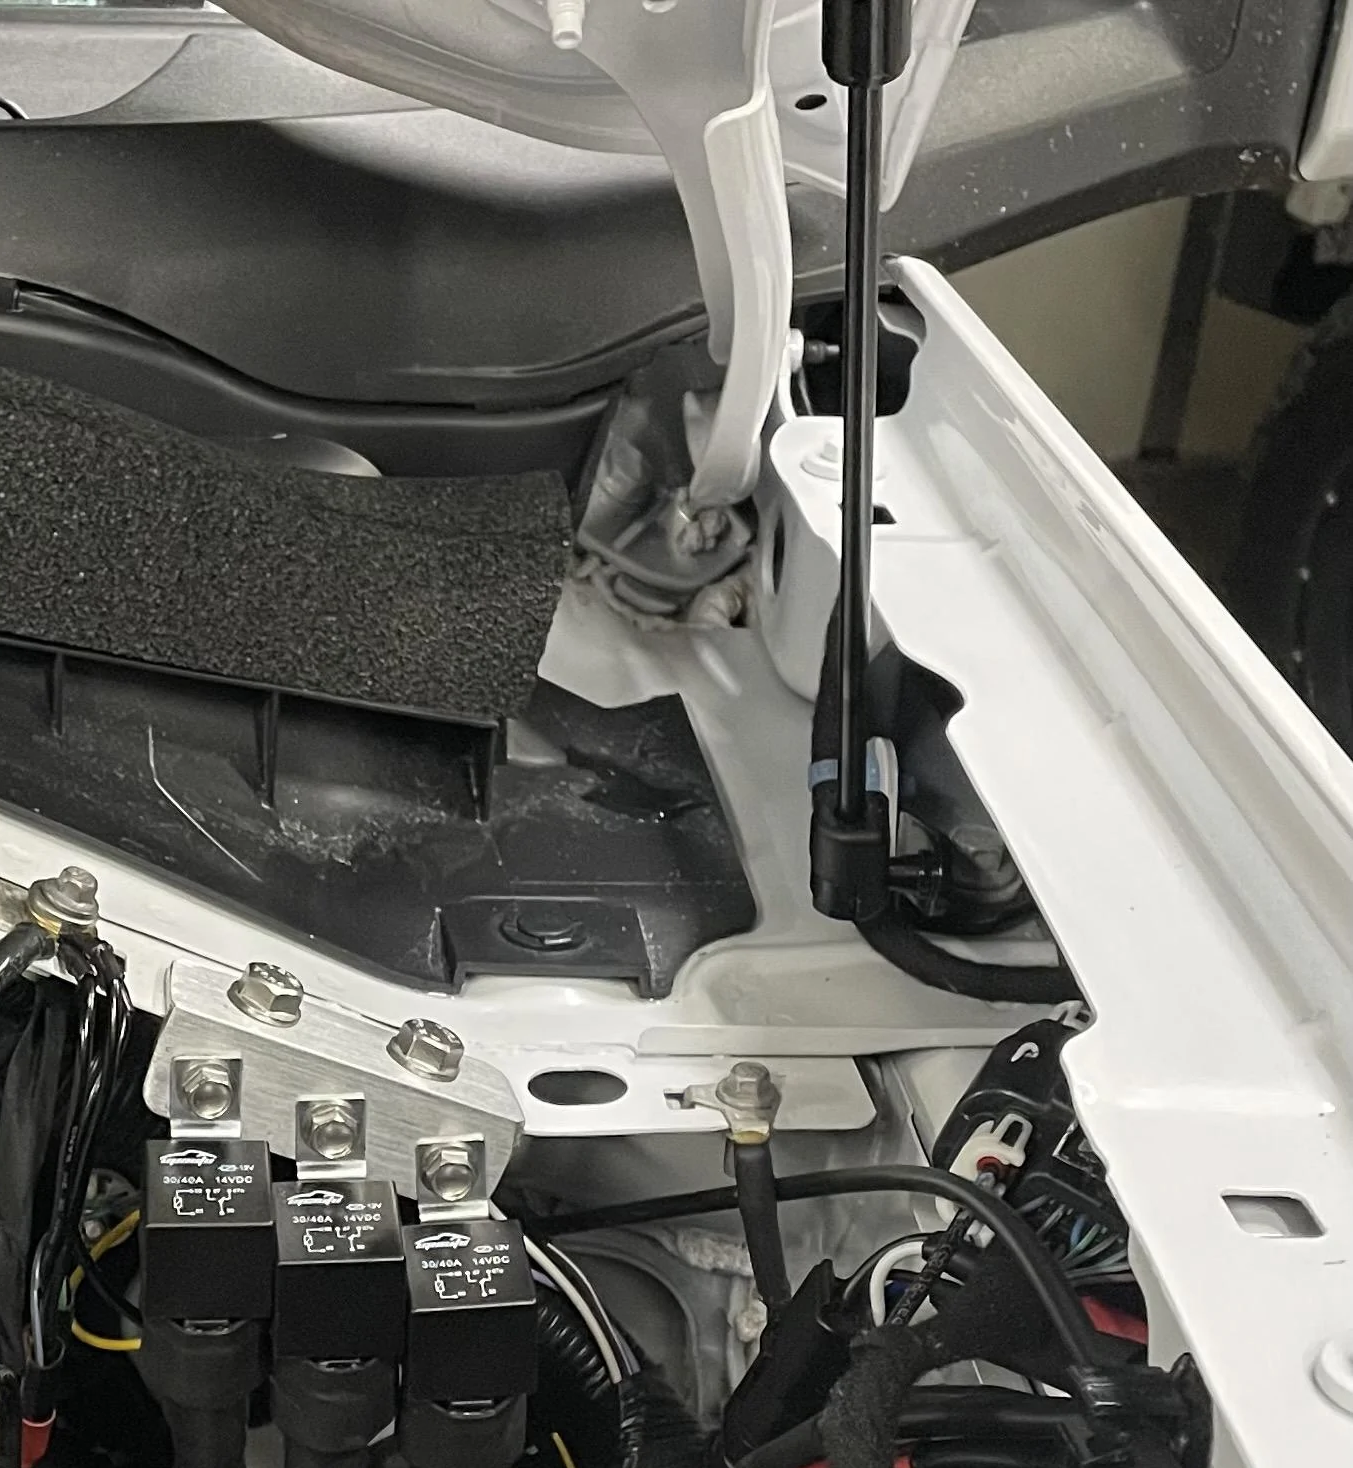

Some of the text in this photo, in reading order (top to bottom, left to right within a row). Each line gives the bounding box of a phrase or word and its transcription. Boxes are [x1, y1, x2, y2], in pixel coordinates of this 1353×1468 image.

[163, 1175, 253, 1184] 30/40A 14VDC
[343, 1213, 382, 1222] 14VDC
[422, 1256, 510, 1269] 30/40A 14VDC
